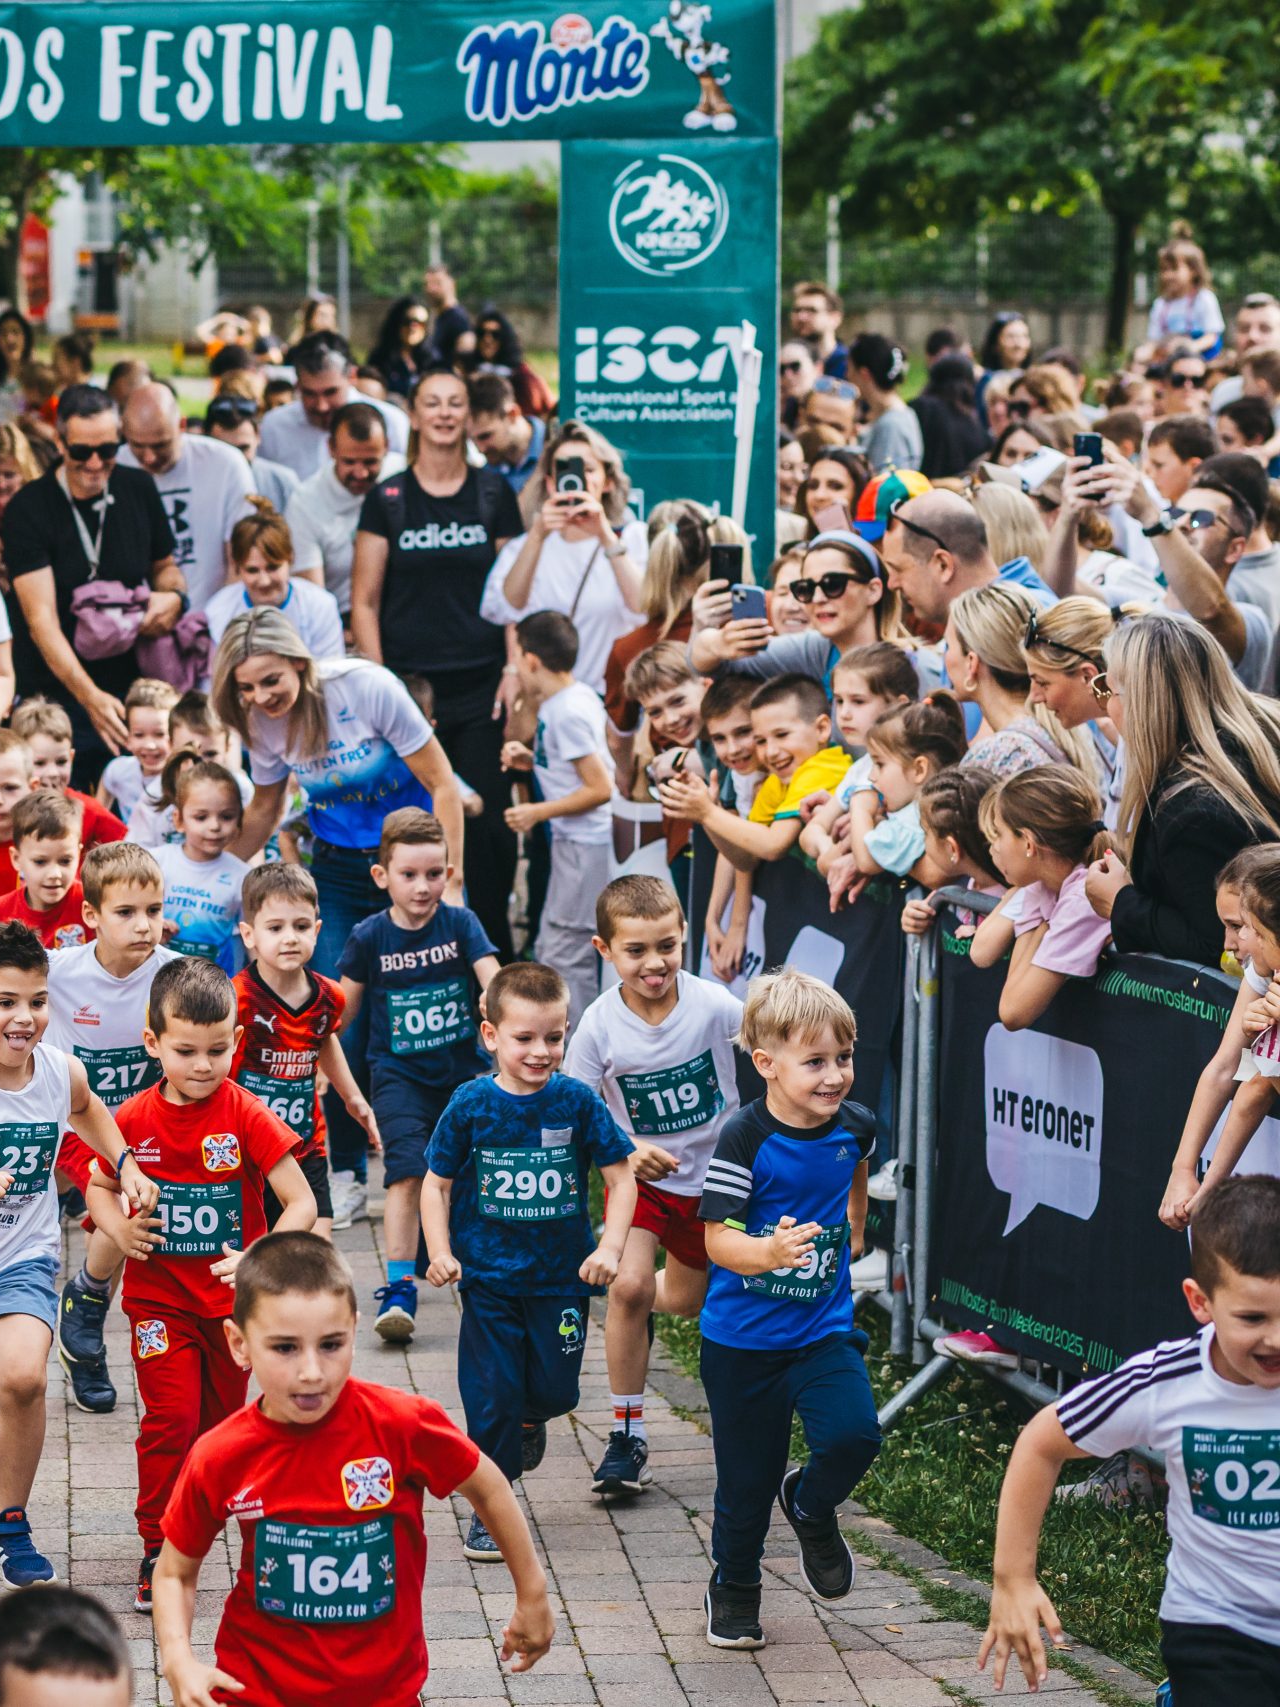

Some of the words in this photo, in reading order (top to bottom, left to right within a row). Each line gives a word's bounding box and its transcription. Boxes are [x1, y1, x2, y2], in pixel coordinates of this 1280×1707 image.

[458, 17, 649, 125] Monte
[575, 389, 679, 404] International
[681, 388, 726, 406] Sport
[574, 406, 637, 421] Culture
[639, 406, 734, 421] Association
[398, 521, 488, 551] adidas
[163, 896, 197, 908] LUTEN
[379, 941, 459, 972] BOSTON
[1121, 977, 1219, 1022] www.mostar.run
[404, 1001, 460, 1035] 062
[96, 1061, 149, 1091] 217
[647, 1082, 700, 1117] 119
[993, 1087, 1019, 1127] HT
[494, 1169, 562, 1201] 290
[156, 1203, 219, 1235] 150
[503, 1206, 516, 1217] LET
[517, 1207, 539, 1218] KIDS
[540, 1206, 556, 1216] RUN
[176, 1242, 198, 1253] KIDS
[199, 1241, 216, 1252] RUN
[771, 1283, 786, 1295] LET
[788, 1286, 813, 1298] KIDS
[987, 1299, 1007, 1324] Run
[1008, 1306, 1055, 1344] Weekend
[1054, 1327, 1086, 1358] 2025.
[287, 1552, 372, 1596] 164
[292, 1602, 310, 1618] LET
[314, 1604, 343, 1618] KIDS
[346, 1603, 367, 1617] RUN
